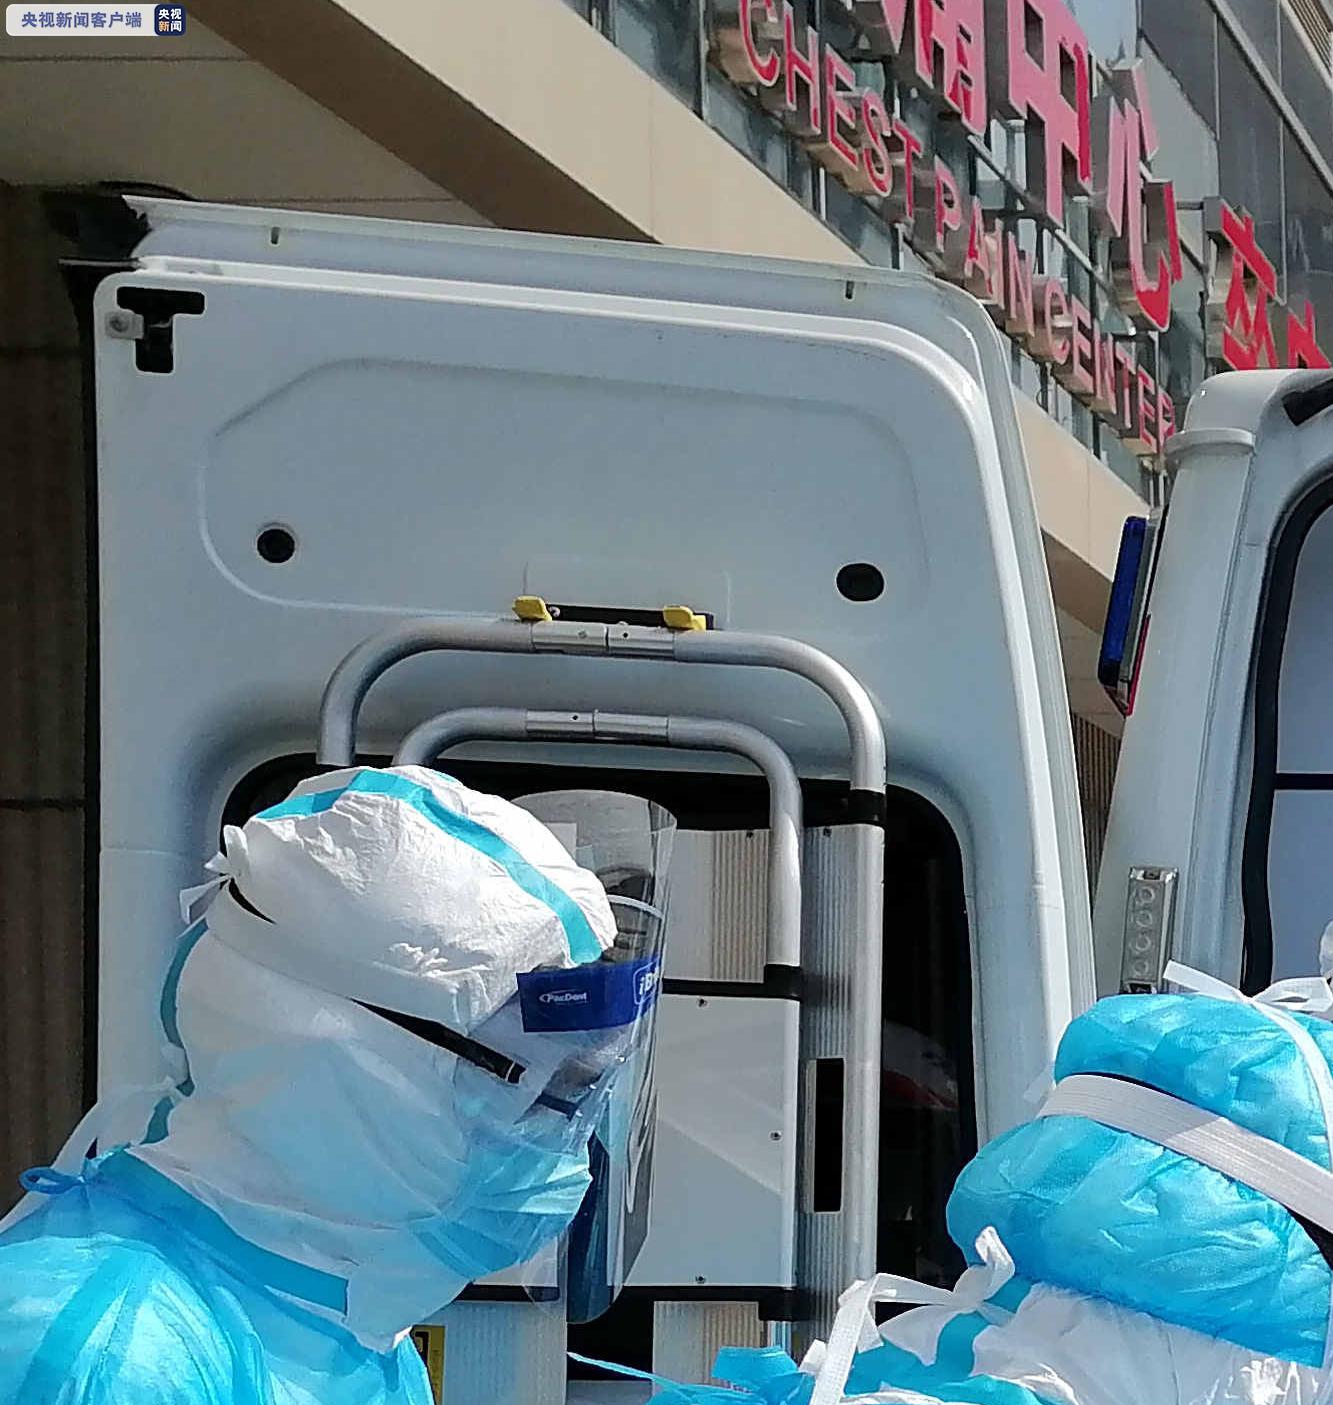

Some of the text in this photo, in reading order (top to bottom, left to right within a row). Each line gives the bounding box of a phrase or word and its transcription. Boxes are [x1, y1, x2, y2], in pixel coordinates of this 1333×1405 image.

[739, 0, 1176, 452] CHEST PAIN CENTER
